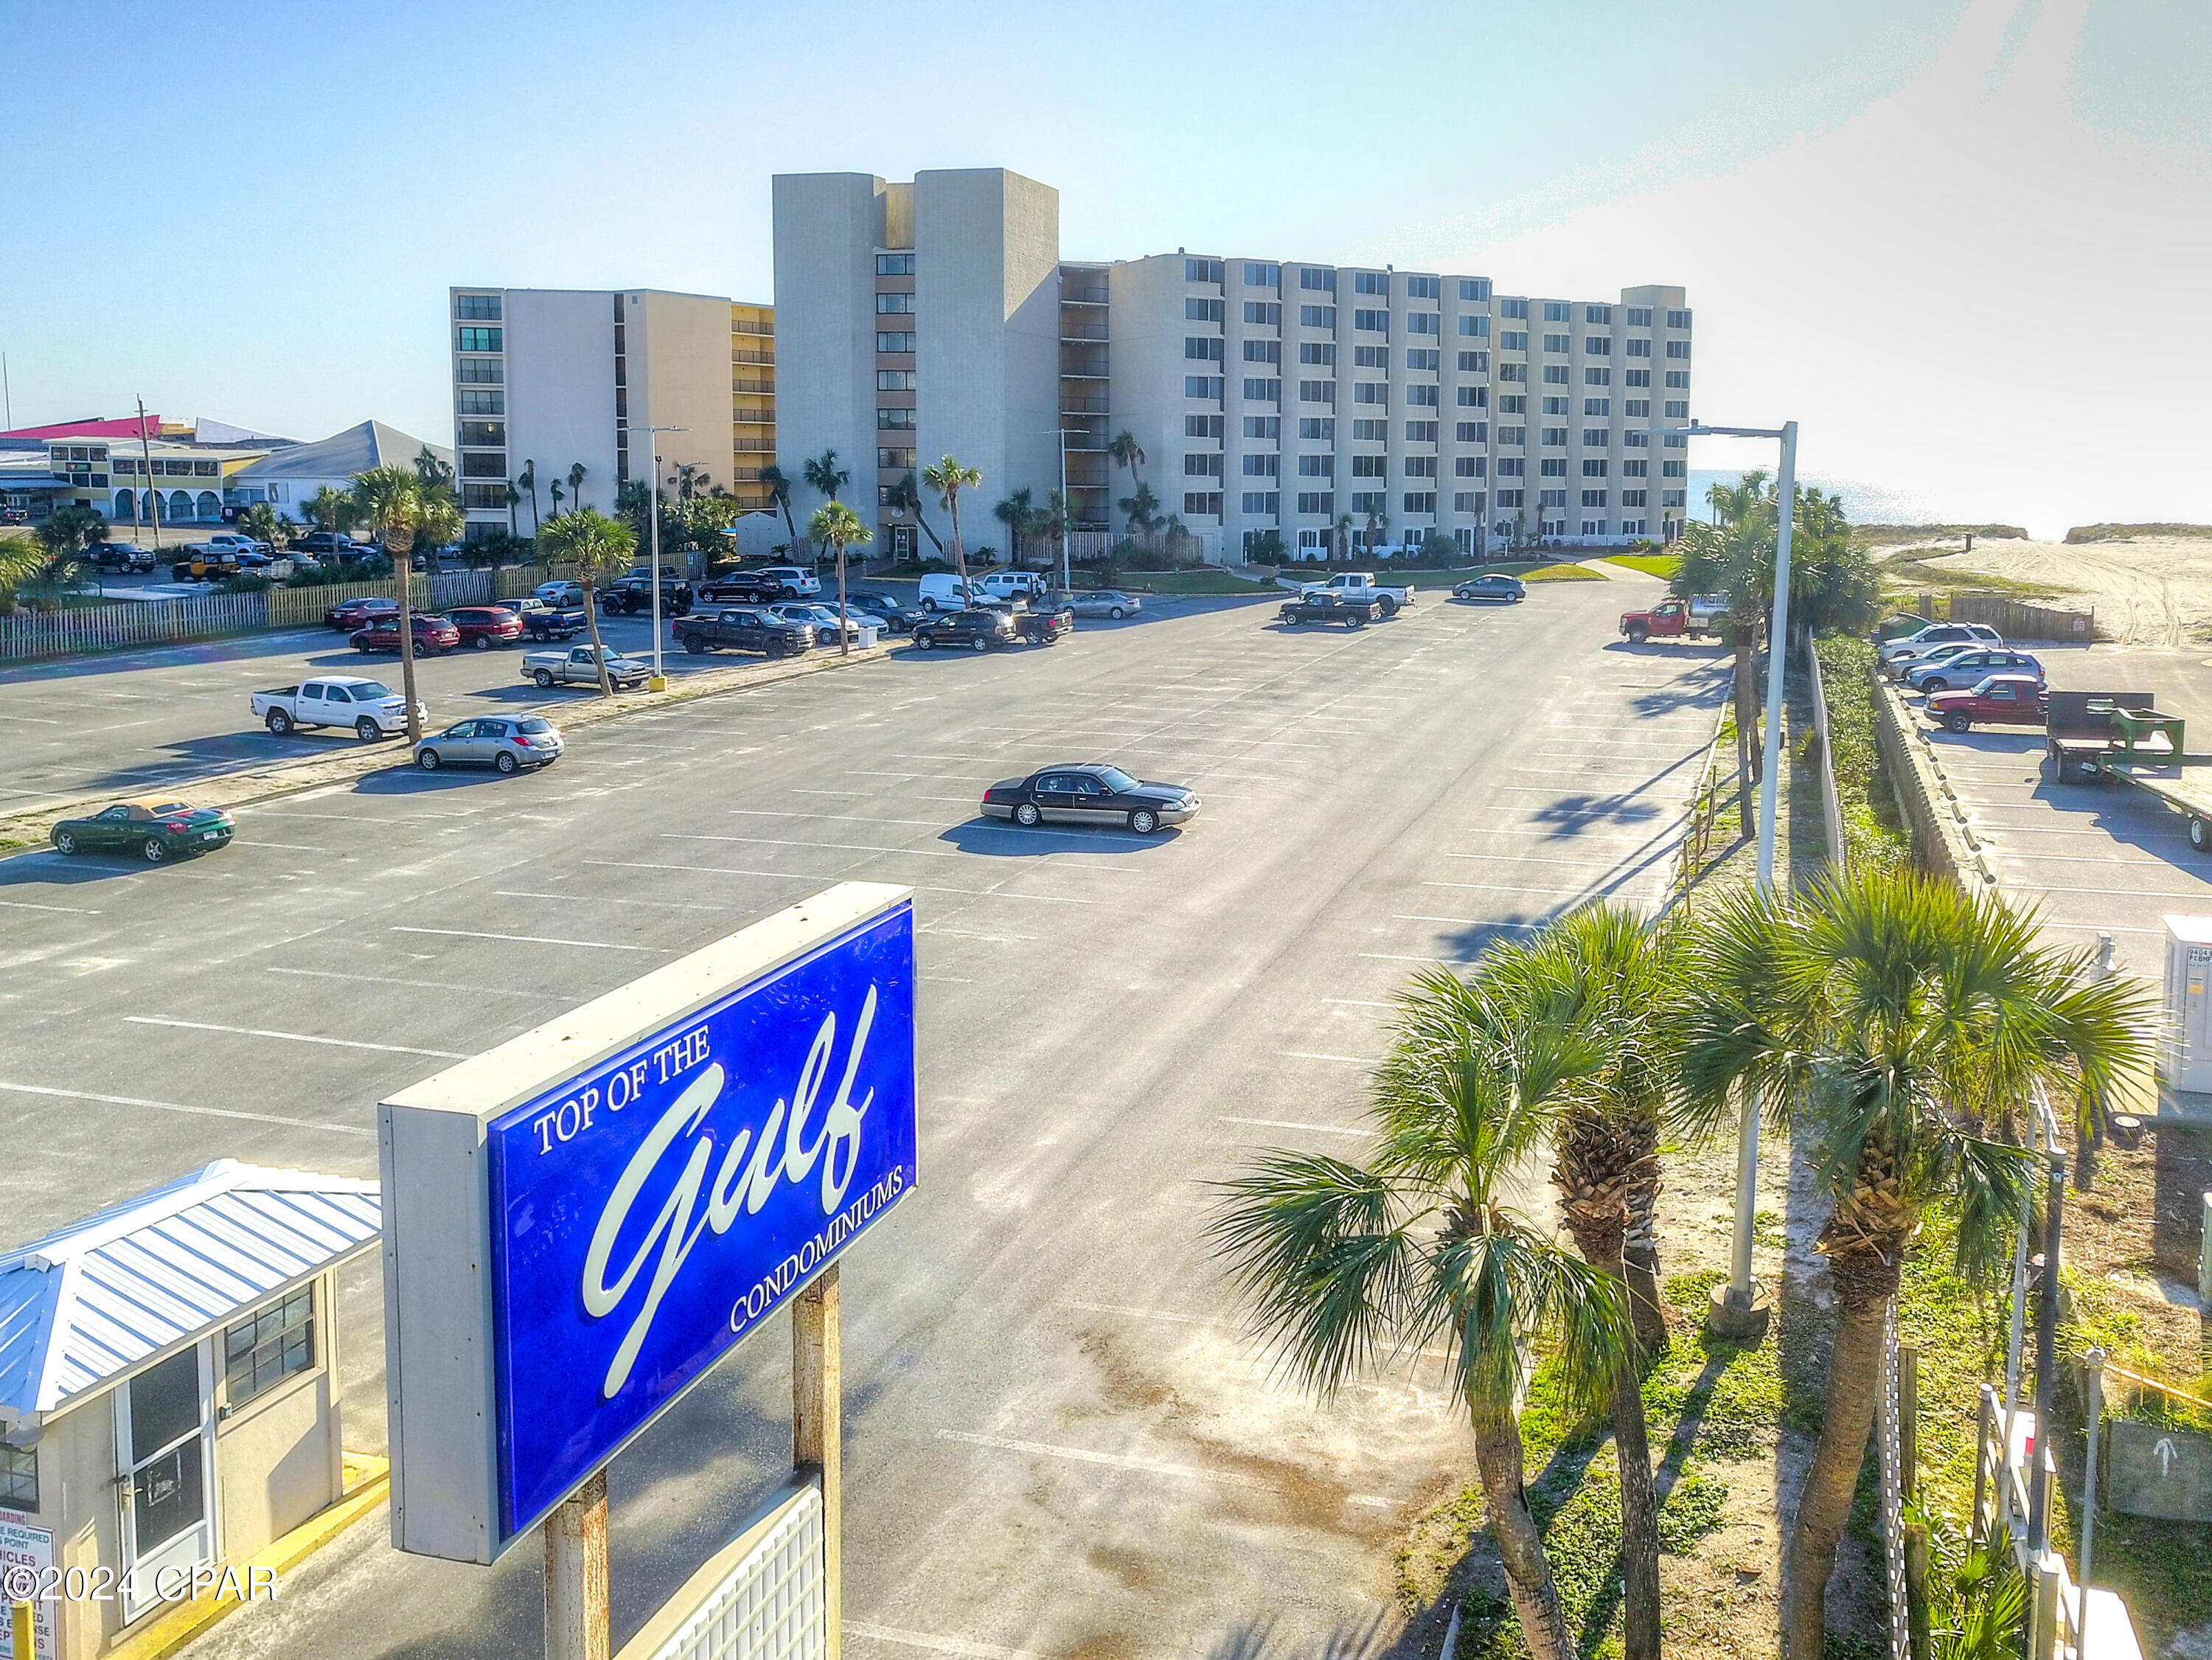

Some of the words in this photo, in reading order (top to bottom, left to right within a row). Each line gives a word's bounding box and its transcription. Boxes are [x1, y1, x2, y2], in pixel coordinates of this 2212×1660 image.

[534, 1088, 599, 1156] TOP
[608, 1060, 647, 1112] OF
[654, 1024, 710, 1085] THE
[730, 1164, 902, 1333] CONDOMINIUMS
[4, 1537, 29, 1550] POINT
[7, 1528, 49, 1544] REQUIRED
